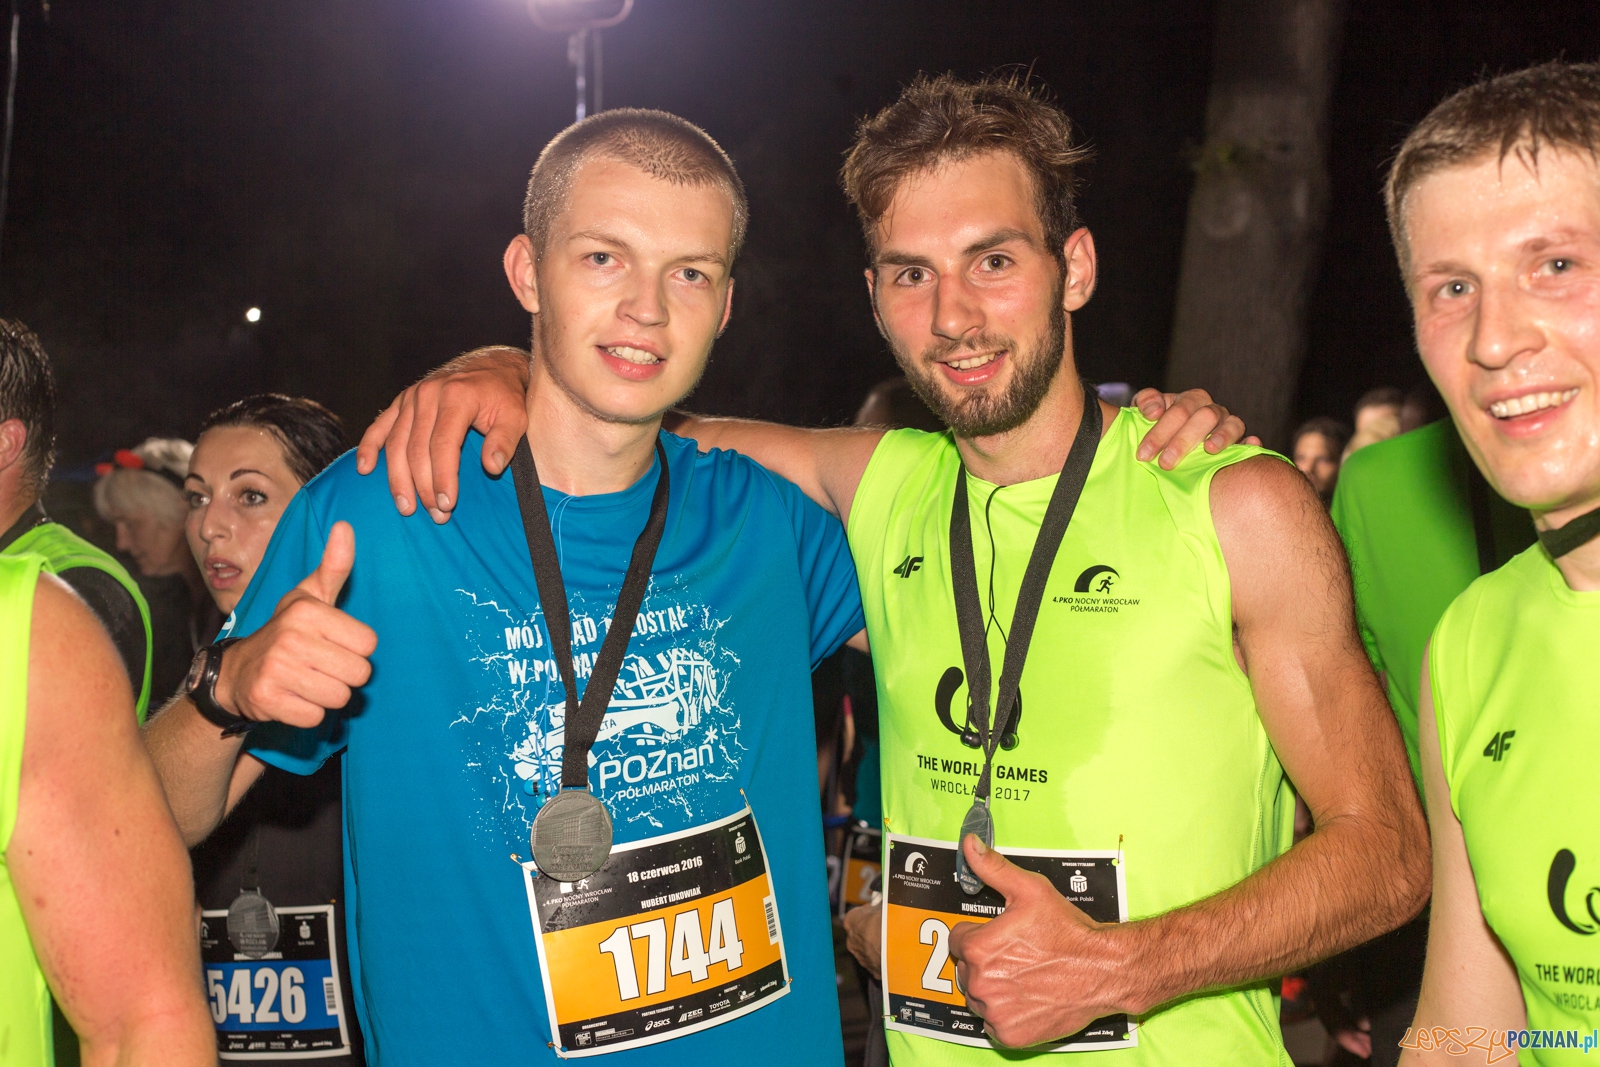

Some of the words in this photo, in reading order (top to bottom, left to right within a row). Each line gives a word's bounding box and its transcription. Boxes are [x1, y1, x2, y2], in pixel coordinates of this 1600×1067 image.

[893, 555, 924, 578] 4F
[1070, 605, 1119, 613] PÓŁMARATON
[1075, 597, 1101, 605] NOCNY
[1102, 598, 1141, 606] WROCŁAW
[507, 658, 527, 685] W
[1482, 730, 1516, 762] 4F
[916, 755, 938, 771] THE
[941, 759, 981, 777] WORL
[996, 765, 1048, 784] GAMES
[618, 772, 700, 802] PÓŁMARATON
[931, 778, 978, 796] WROCŁA
[995, 786, 1031, 802] 2017
[626, 871, 640, 884] 18
[640, 863, 681, 881] czerwca
[681, 855, 703, 872] 2016
[563, 893, 585, 902] NOCNY
[641, 895, 668, 910] HUBERT
[961, 902, 996, 915] KONSTANTY
[599, 897, 744, 1002] 1744
[1535, 964, 1560, 982] THE
[206, 966, 307, 1024] 5426
[709, 999, 731, 1010] TOYOTA
